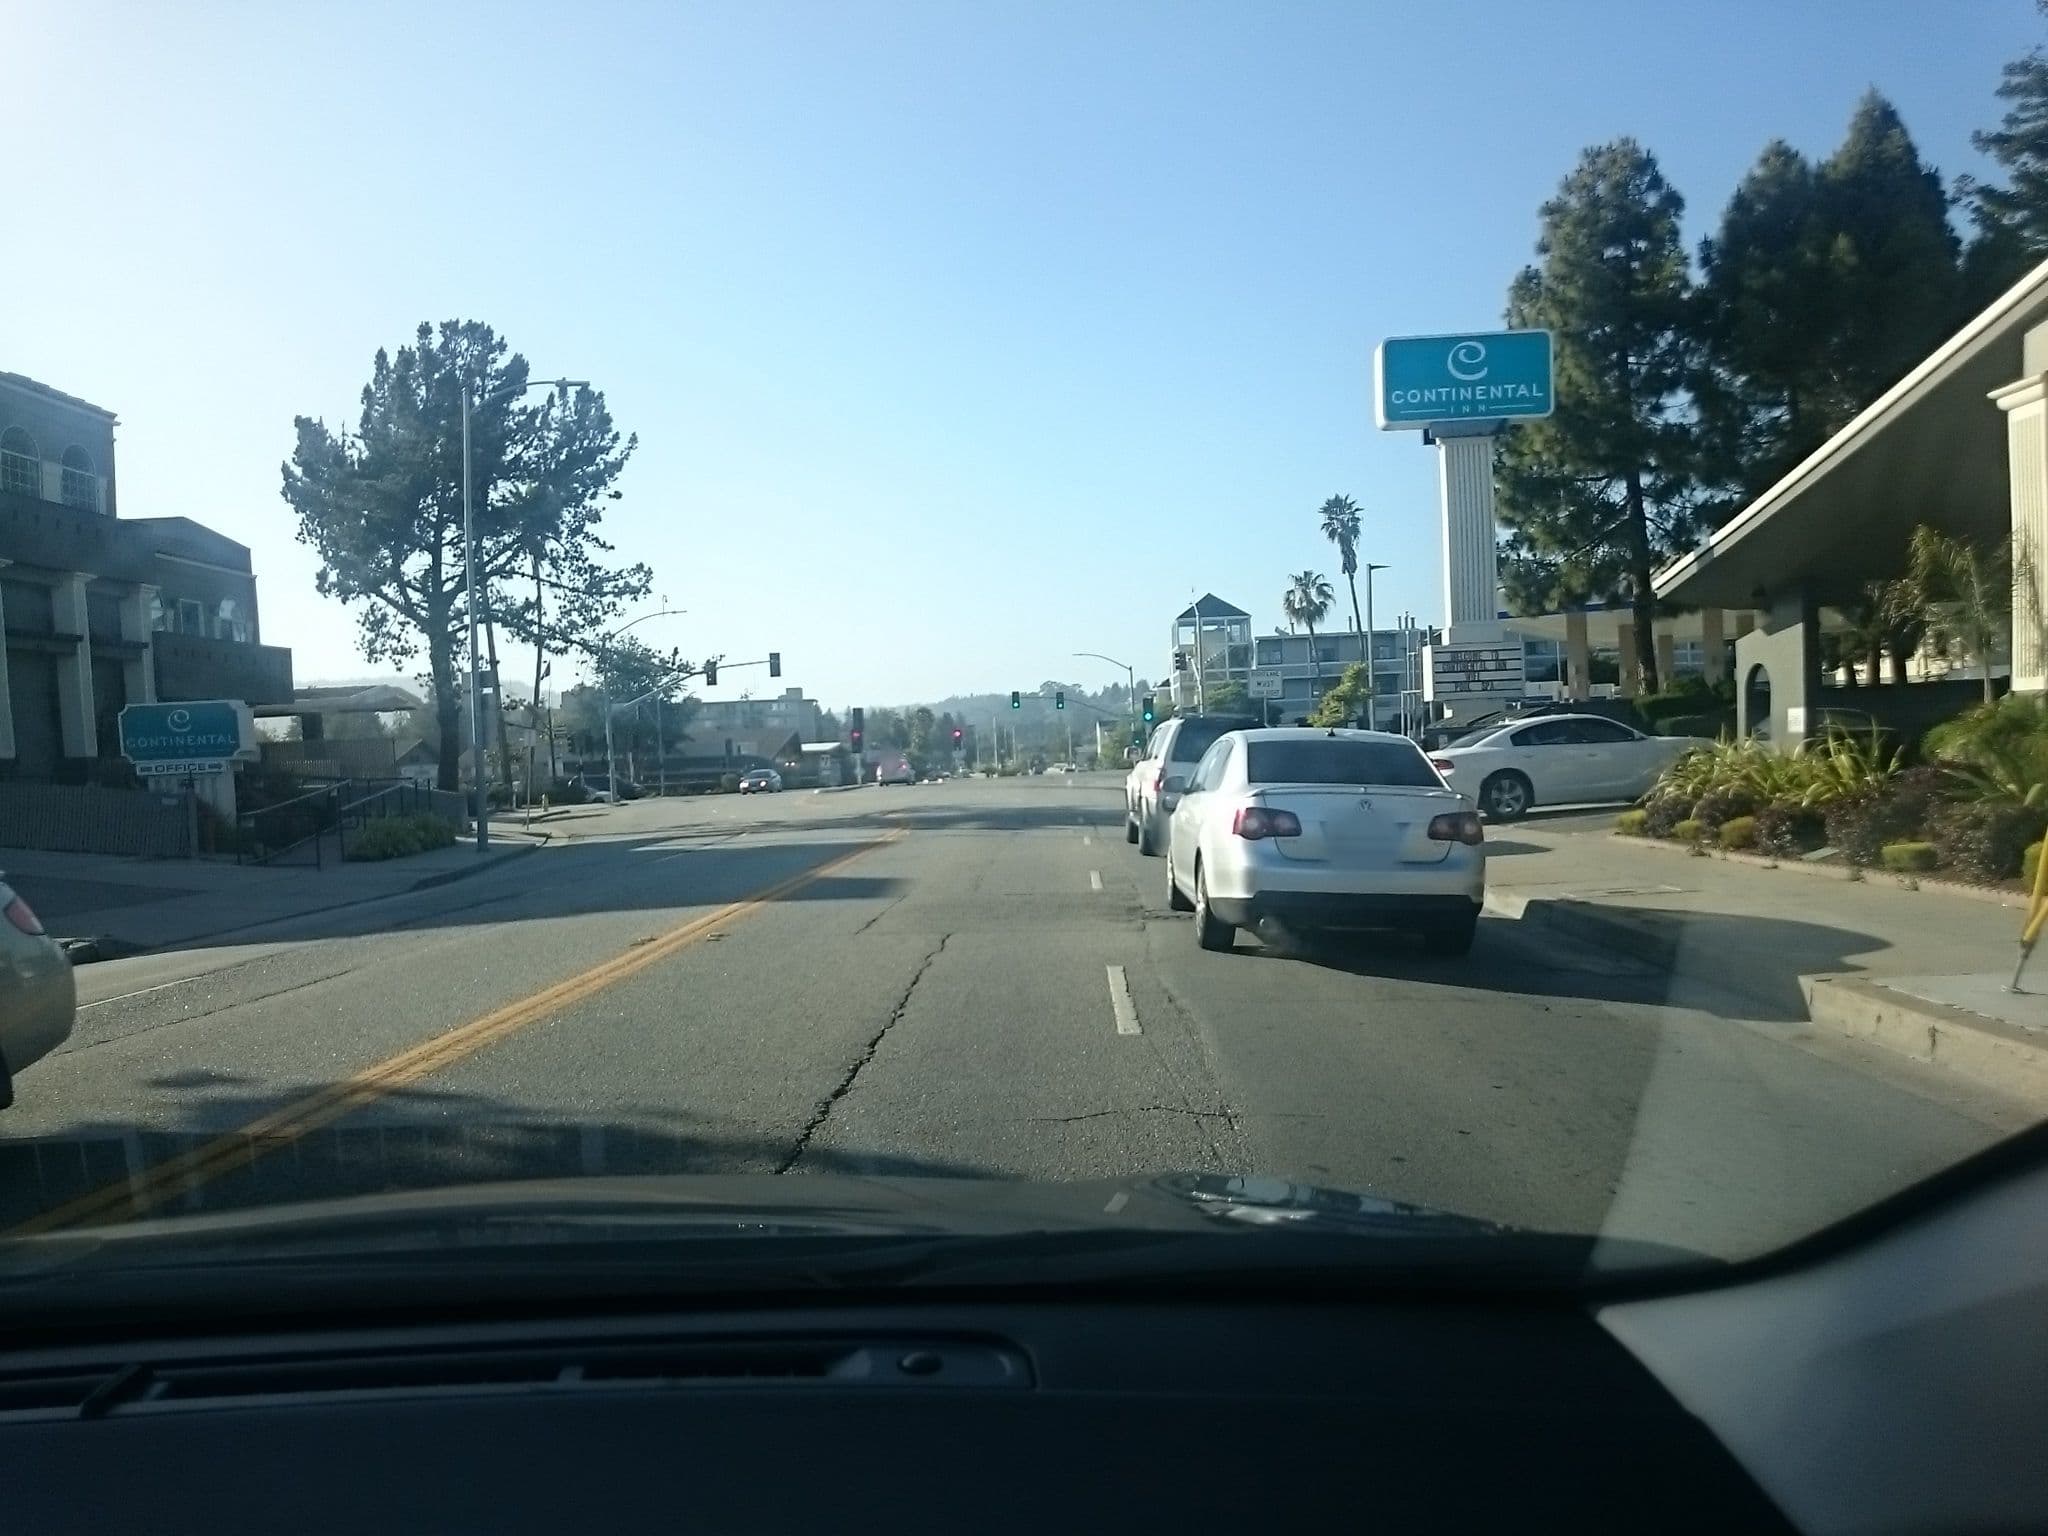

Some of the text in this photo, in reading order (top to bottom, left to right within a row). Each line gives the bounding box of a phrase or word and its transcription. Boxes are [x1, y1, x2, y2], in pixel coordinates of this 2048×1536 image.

[1391, 383, 1544, 405] CONTINENTAL
[1450, 404, 1486, 414] INN
[126, 734, 236, 748] CONTINENTAL
[154, 763, 206, 773] OFFICE
